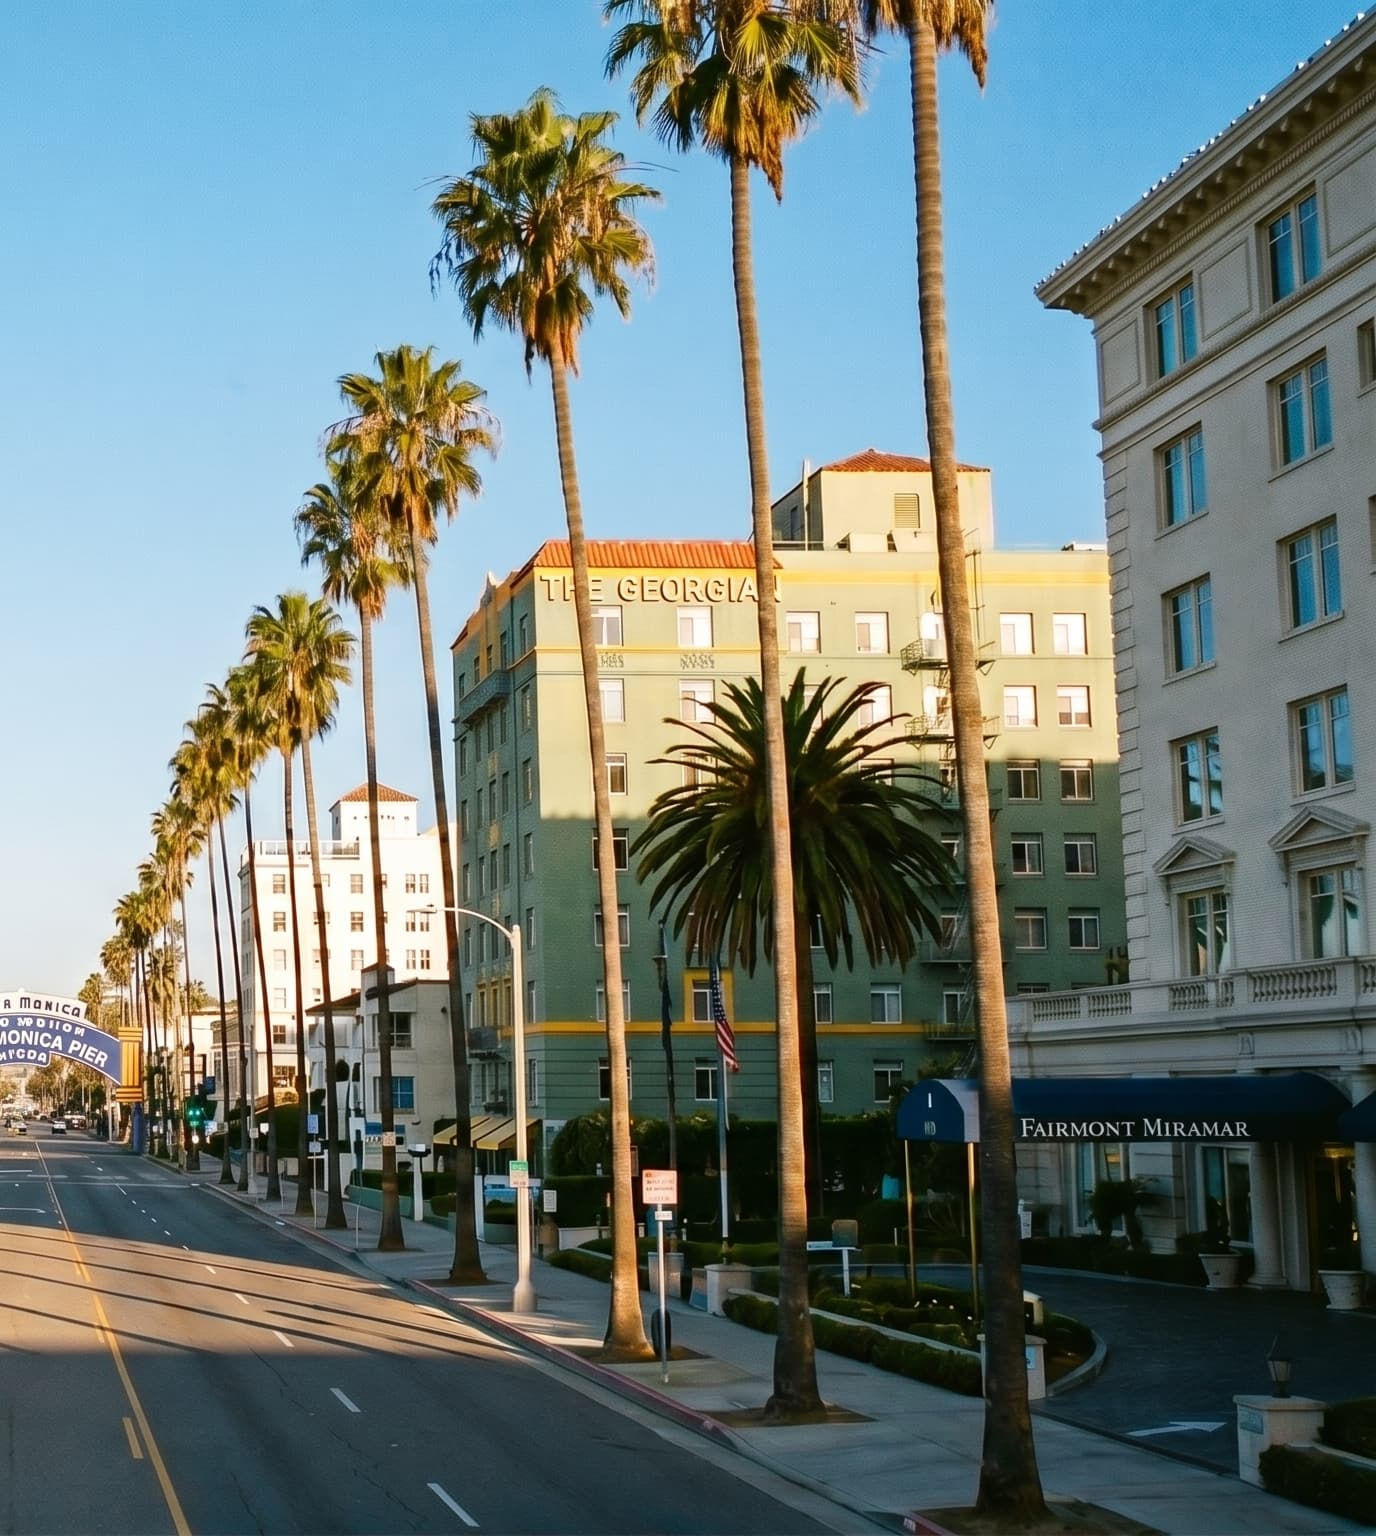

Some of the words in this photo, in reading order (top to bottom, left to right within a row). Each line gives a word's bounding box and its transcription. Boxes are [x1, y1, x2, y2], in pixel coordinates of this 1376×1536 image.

[68, 1040, 109, 1067] PIER
[1020, 1118, 1135, 1137] FAIRMONT
[1143, 1118, 1251, 1137] MIRAMAR
